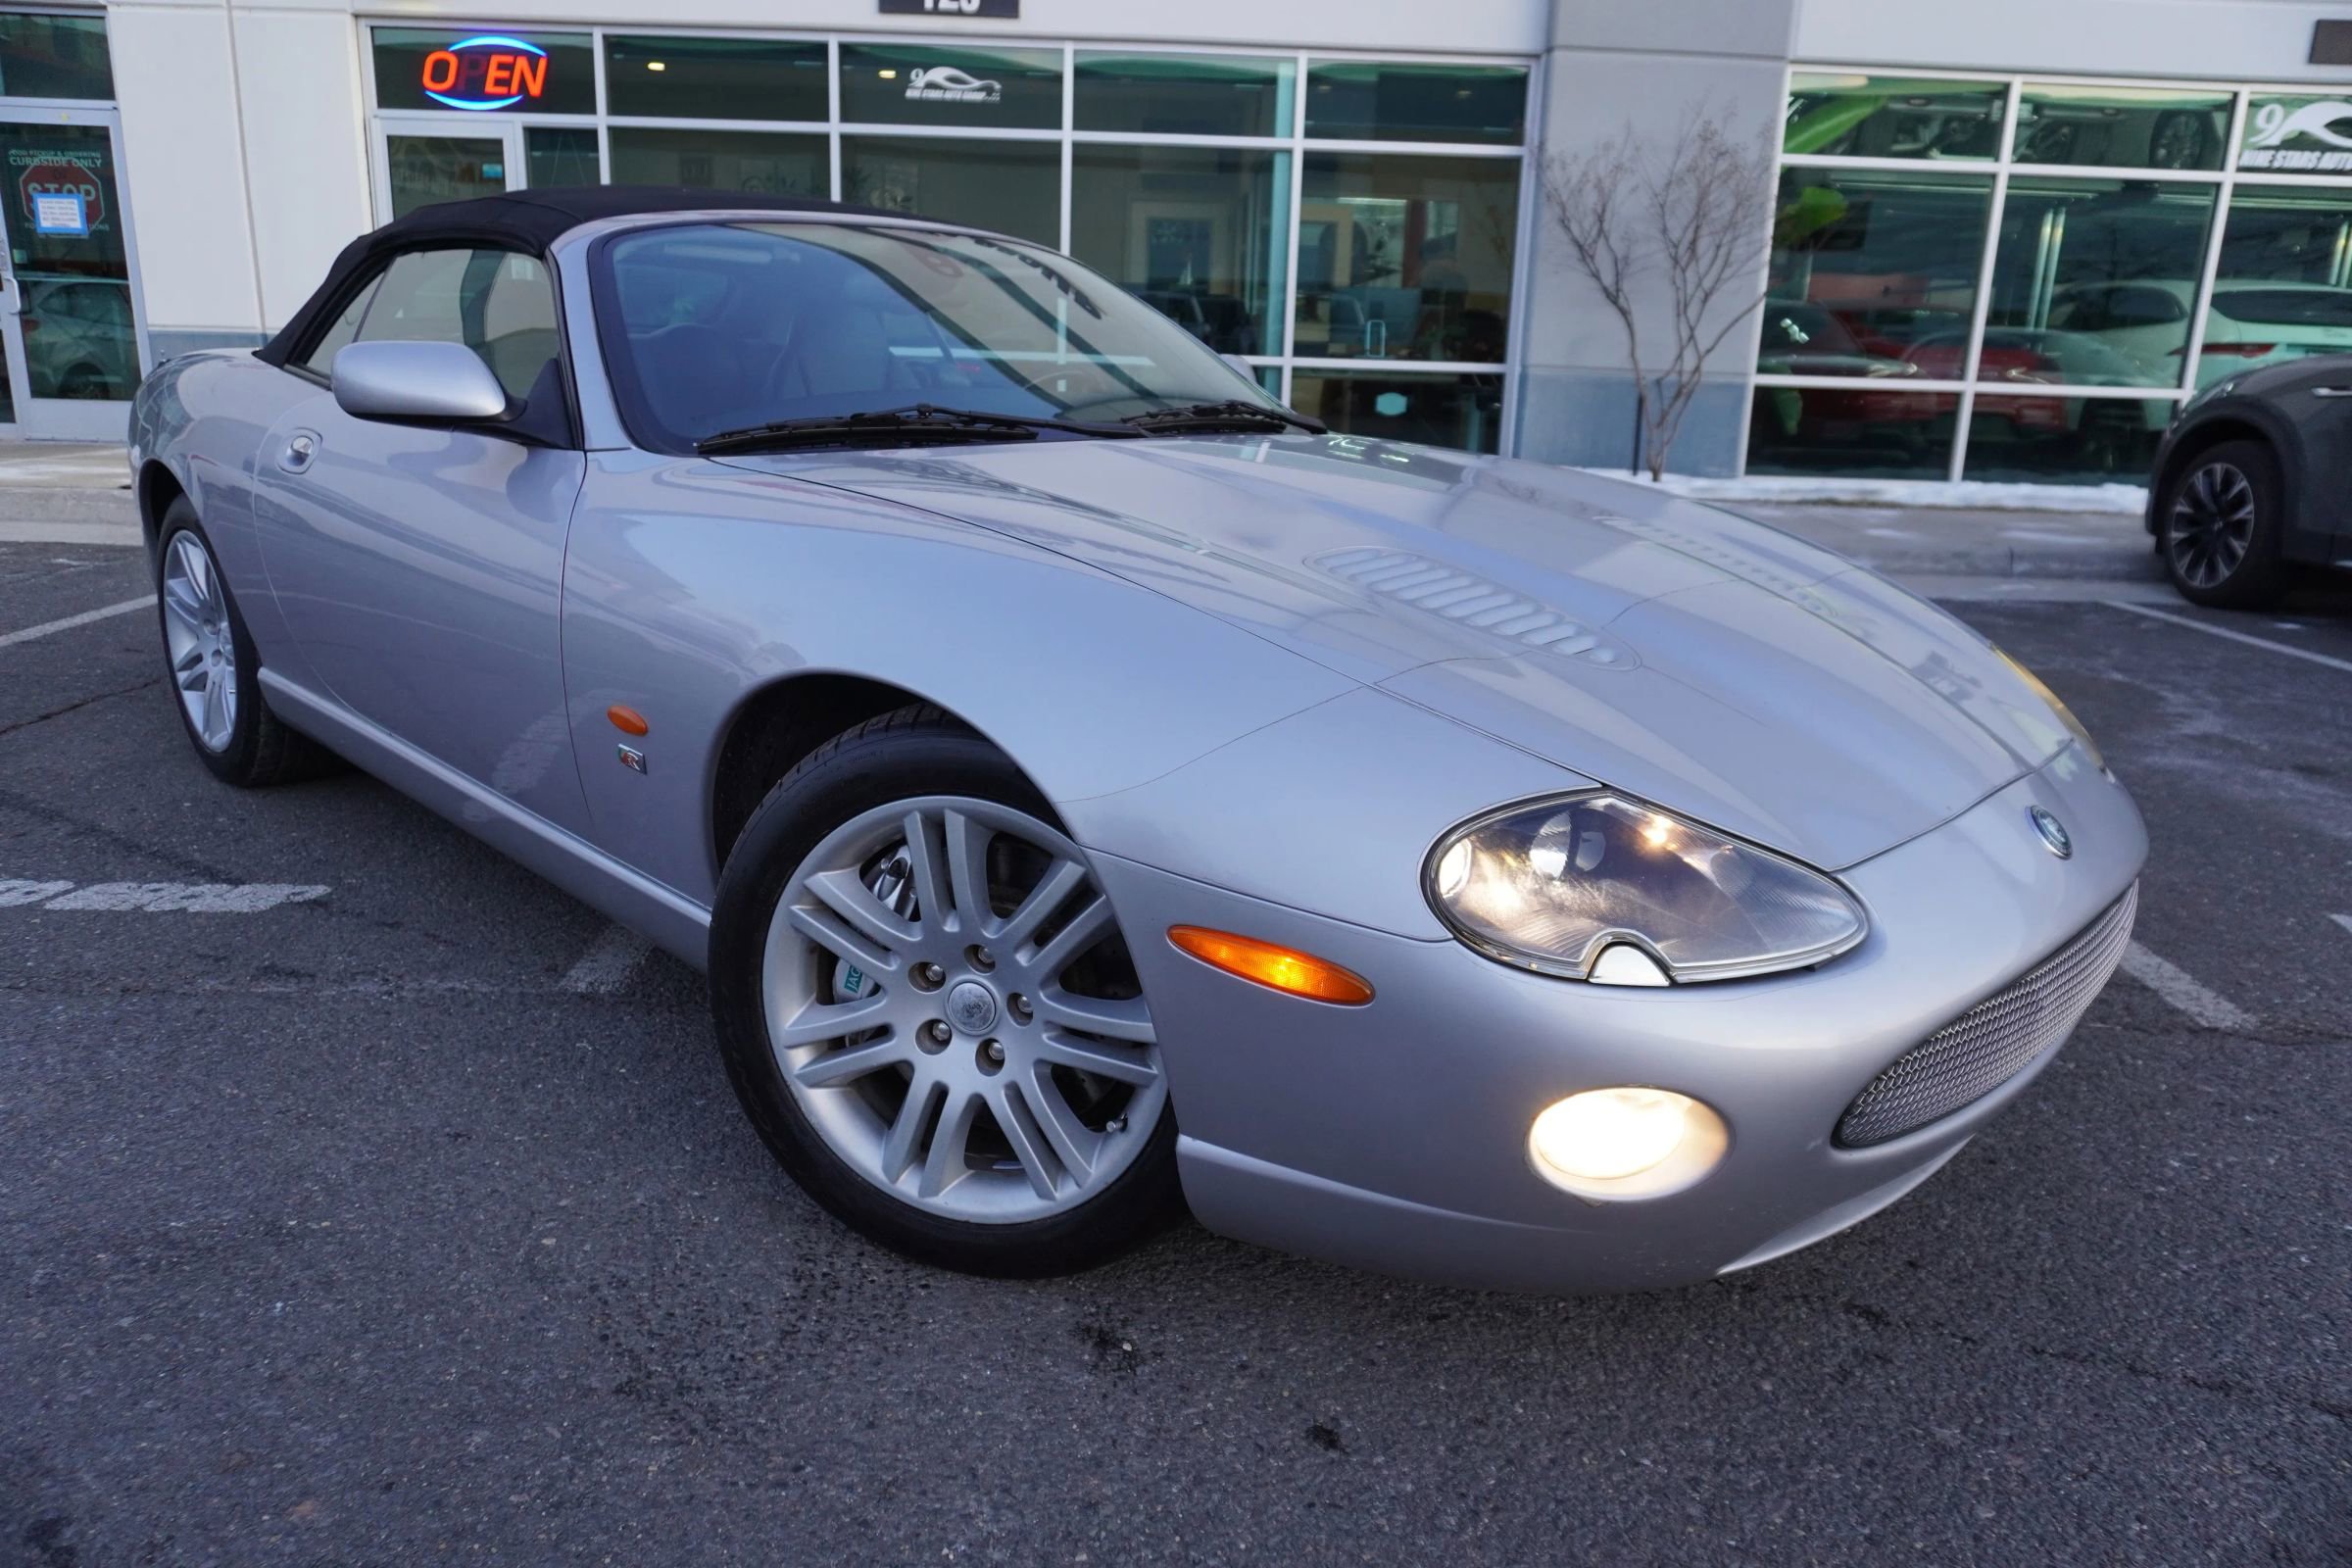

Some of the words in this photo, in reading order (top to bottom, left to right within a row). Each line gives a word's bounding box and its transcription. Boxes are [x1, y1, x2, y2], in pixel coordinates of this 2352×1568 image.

[422, 50, 548, 97] OPEN
[10, 157, 69, 167] CURBSIDE
[72, 157, 102, 168] ONLY
[2272, 149, 2323, 170] STARS
